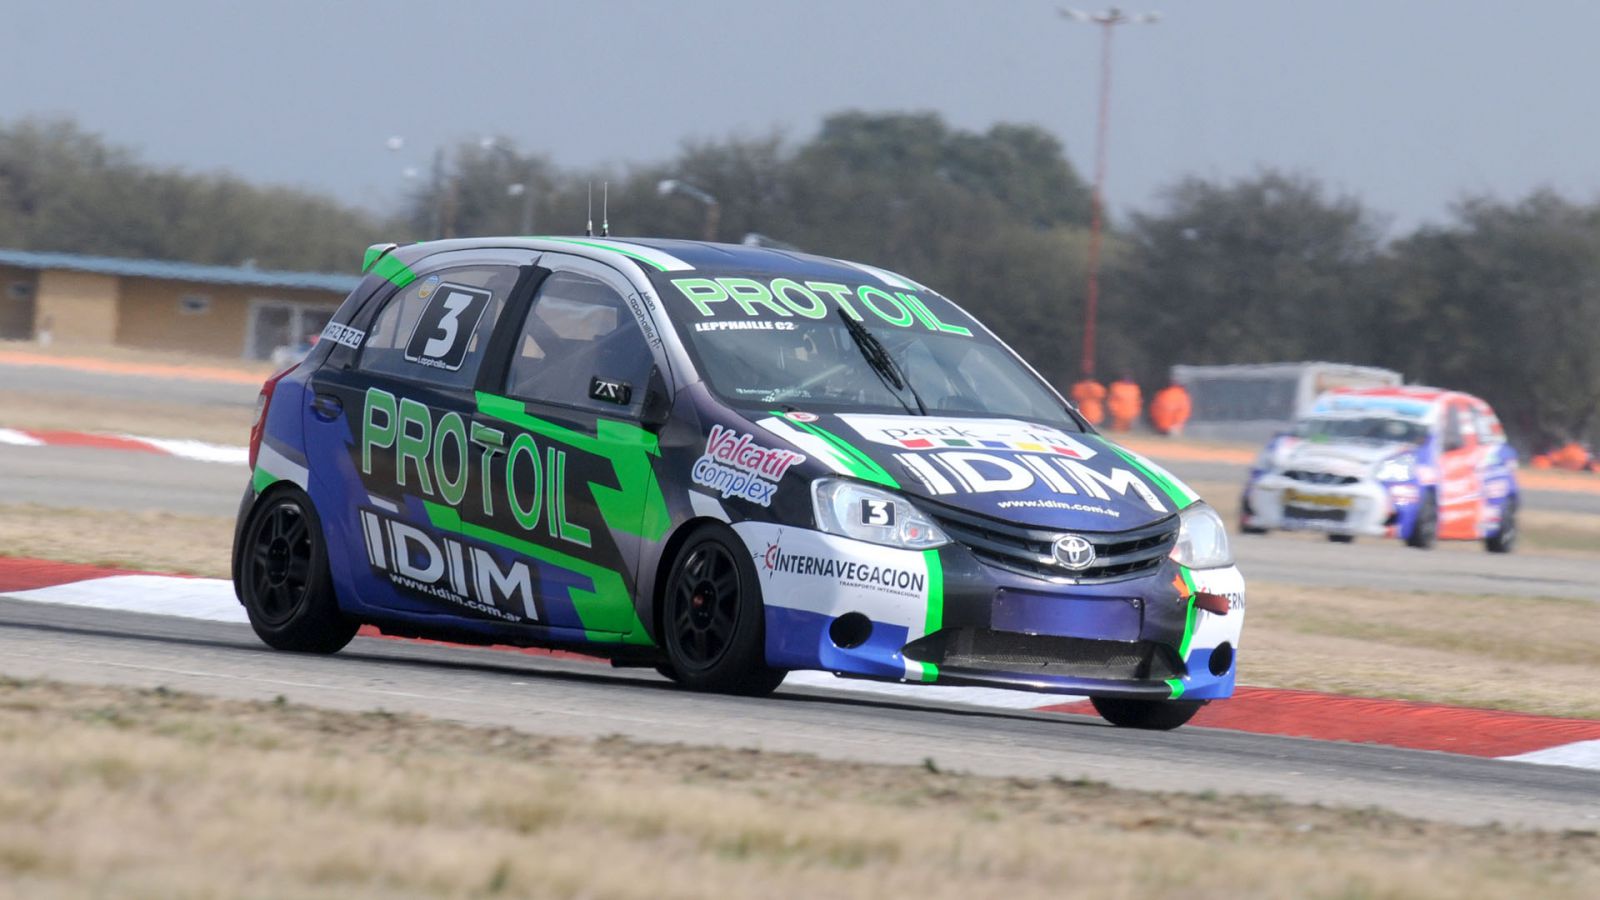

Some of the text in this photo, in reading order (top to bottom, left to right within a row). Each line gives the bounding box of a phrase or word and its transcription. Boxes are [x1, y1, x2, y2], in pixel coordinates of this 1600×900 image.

[423, 292, 473, 358] 3
[671, 277, 973, 337] PROTOIL
[694, 321, 774, 332] LEPPHAILLE
[707, 427, 796, 478] Valcatil
[880, 425, 980, 440] park
[362, 387, 592, 548] PROTOIL
[694, 459, 774, 503] Complex
[891, 451, 1169, 513] IDIM
[868, 500, 889, 526] 3
[997, 499, 1121, 518] www.idim.com.ar
[360, 510, 539, 621] IDIM
[774, 547, 925, 592] INTERNAVEGACION
[389, 572, 523, 622] www.idim.com.ar
